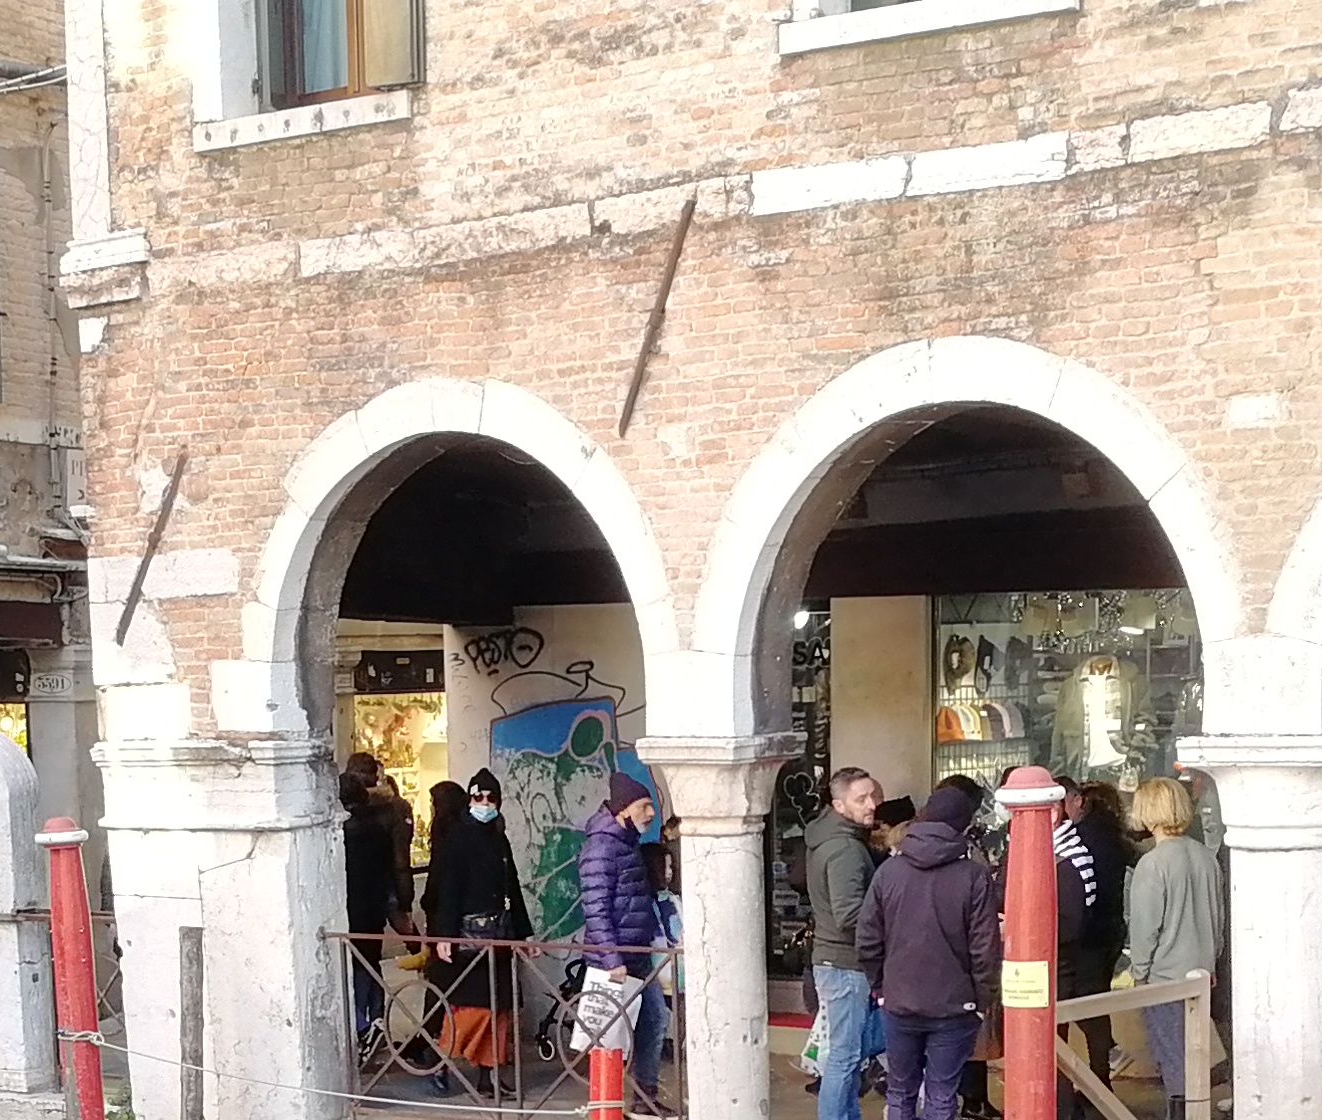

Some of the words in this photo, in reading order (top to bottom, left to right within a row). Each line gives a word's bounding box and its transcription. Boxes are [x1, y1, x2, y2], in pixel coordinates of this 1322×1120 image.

[792, 641, 830, 666] SA
[37, 676, 66, 690] 5591
[583, 1004, 614, 1018] make
